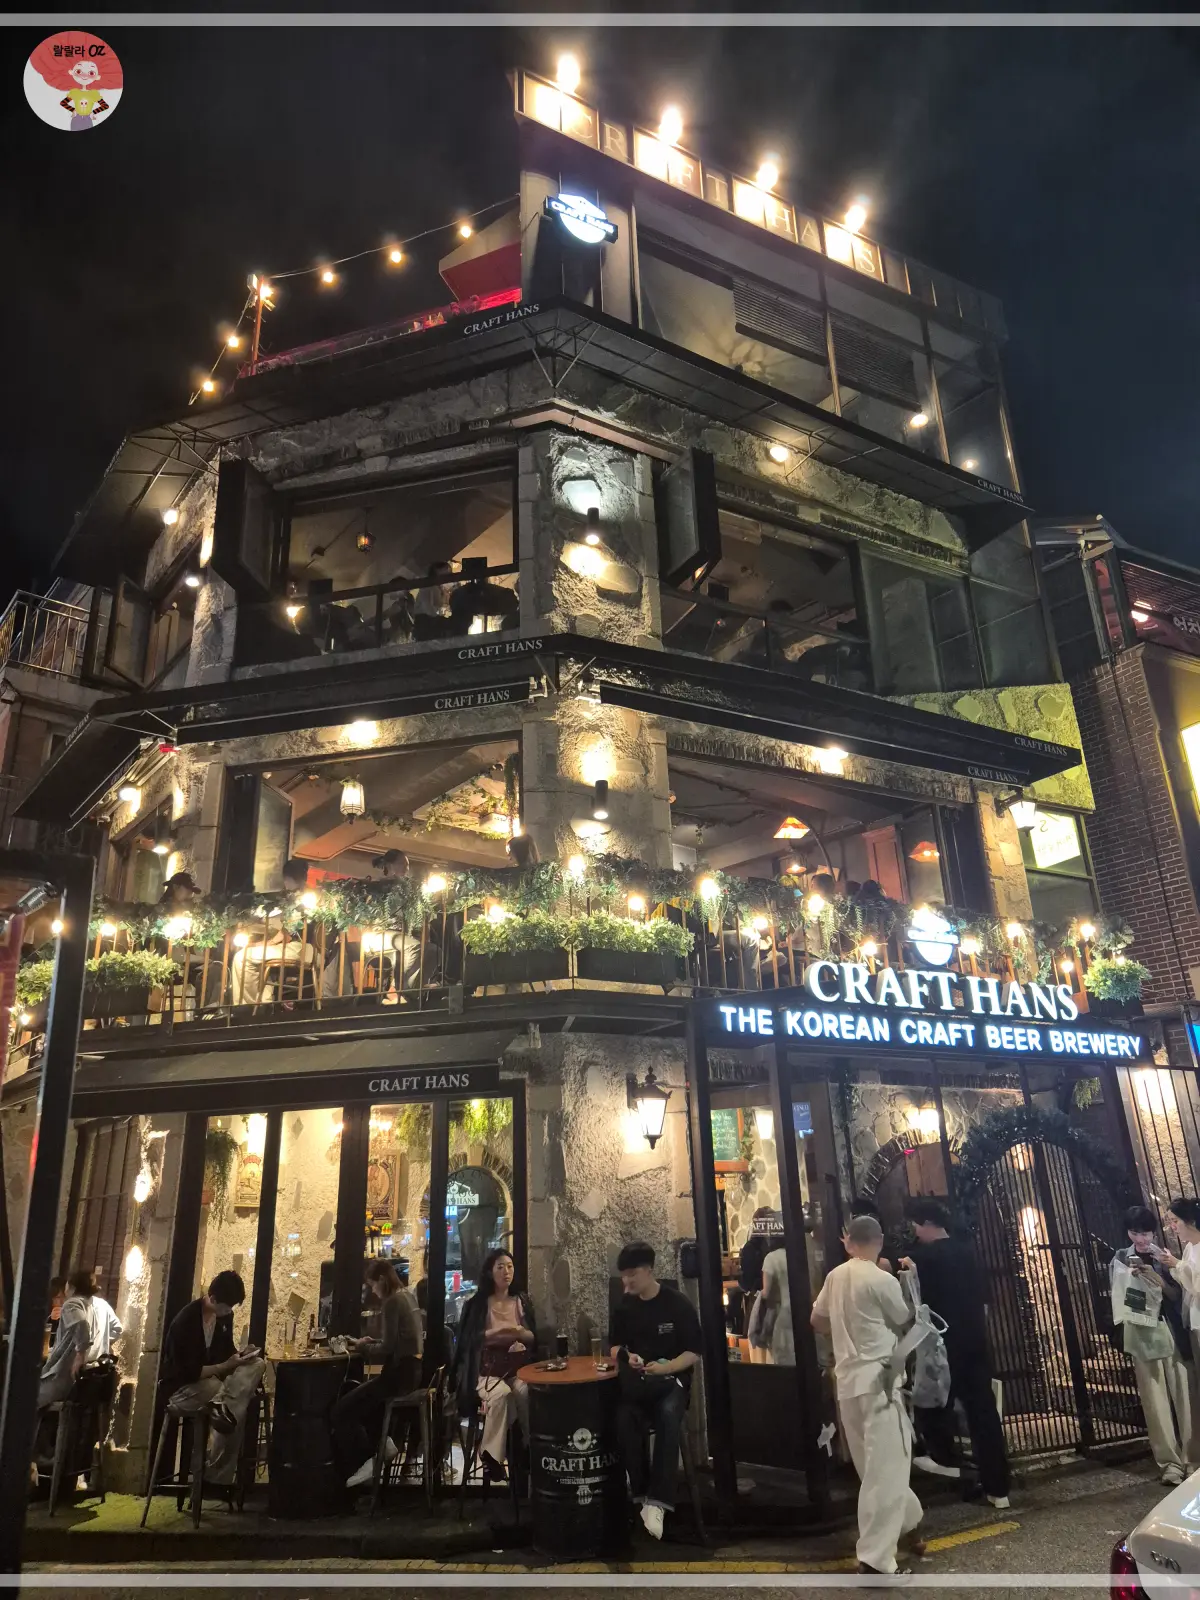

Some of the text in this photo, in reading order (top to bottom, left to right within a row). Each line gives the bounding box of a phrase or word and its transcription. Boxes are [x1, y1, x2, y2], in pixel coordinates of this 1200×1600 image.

[568, 108, 877, 274] CRFT HAS
[463, 303, 540, 335] CRAFT HANS
[977, 479, 1024, 503] CRAFT HANS
[458, 639, 543, 660] CRAFT HANS
[434, 689, 511, 710] CRAFT HANS
[1014, 736, 1068, 757] CRAFT HANS
[967, 765, 1019, 784] CRAFT HANS
[806, 960, 1079, 1021] CRAFT HANS
[719, 1005, 1142, 1057] THE KOREAN CRAFT BEER BREWERY
[368, 1073, 470, 1092] CRAFT HANS
[767, 1222, 784, 1230] HAN
[541, 1456, 587, 1472] CRAFT
